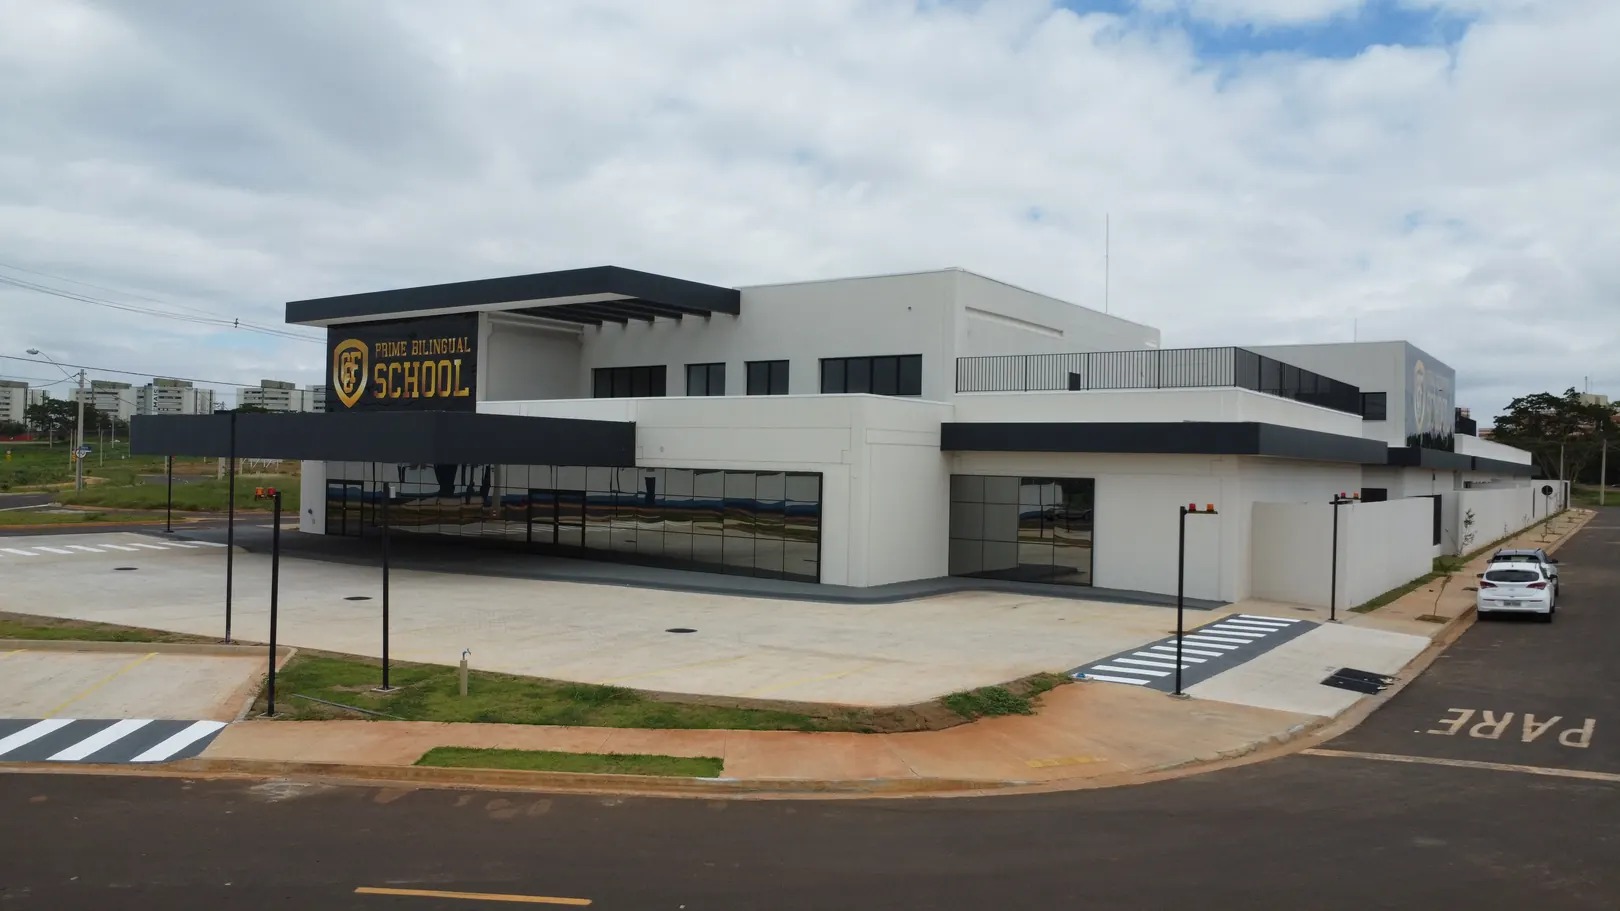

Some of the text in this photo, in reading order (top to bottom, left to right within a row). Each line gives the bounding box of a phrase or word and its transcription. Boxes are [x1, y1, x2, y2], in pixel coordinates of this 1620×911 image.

[375, 336, 471, 358] PRIME BILINGUAL
[373, 359, 470, 399] SCHOOL
[1426, 708, 1597, 748] PARE
